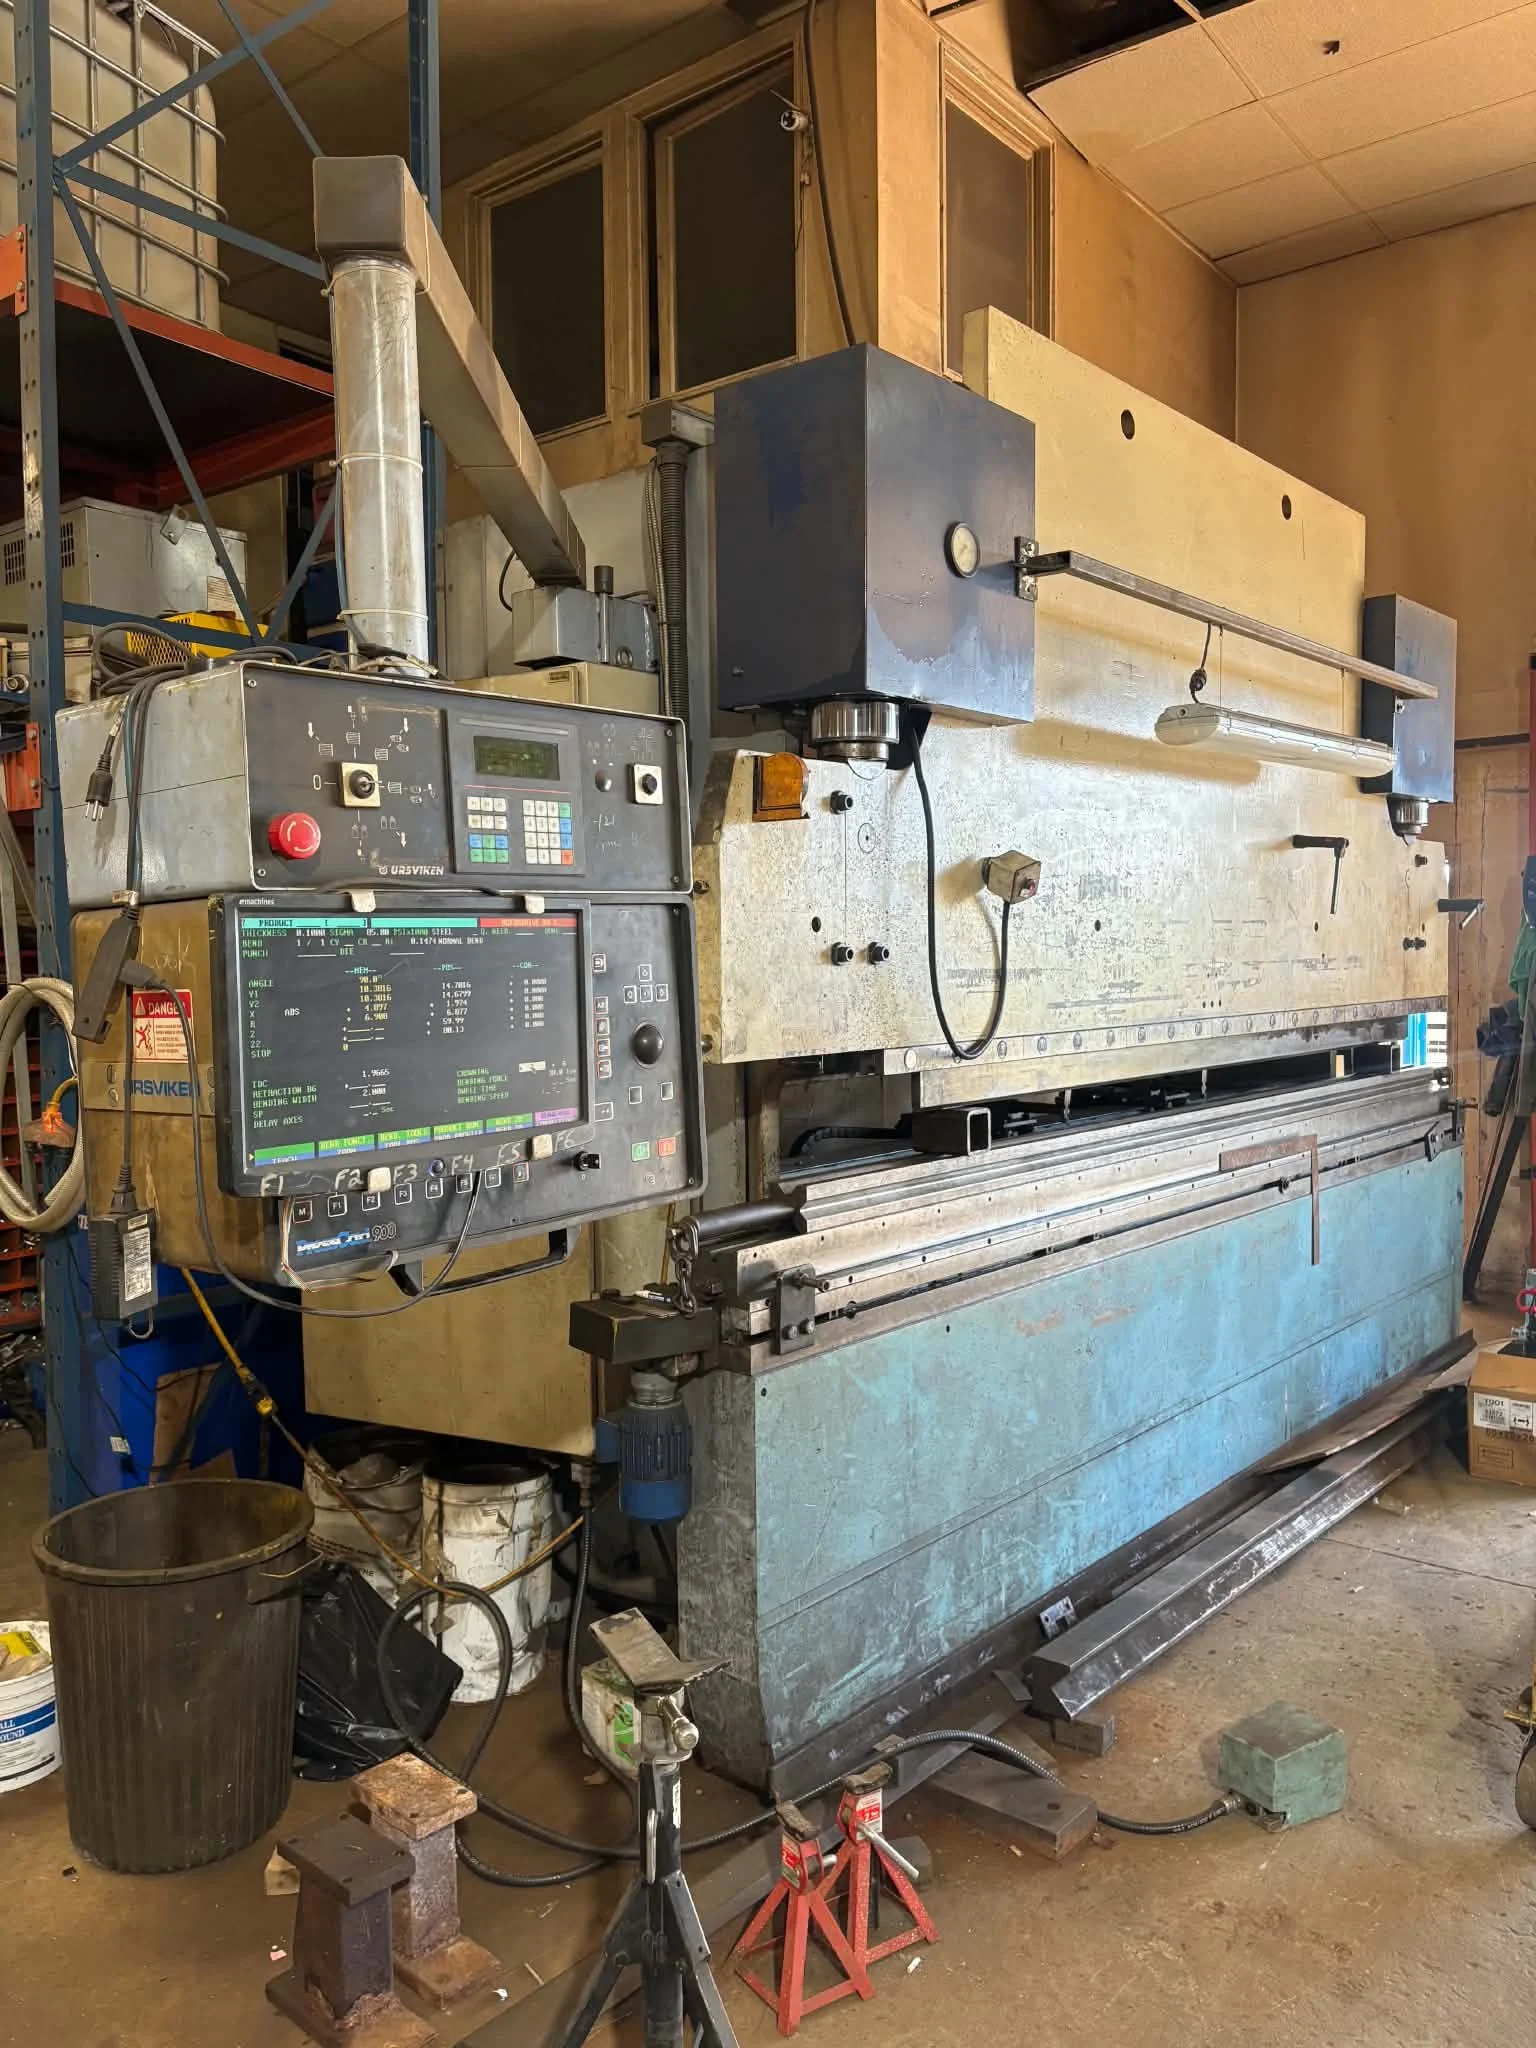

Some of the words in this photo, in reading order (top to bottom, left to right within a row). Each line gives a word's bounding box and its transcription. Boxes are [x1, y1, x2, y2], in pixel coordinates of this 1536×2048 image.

[390, 866, 444, 876] URSVIKEN
[258, 919, 293, 927] PRODUCT
[242, 929, 288, 937] THICKNESS
[148, 1001, 185, 1016] DANGE
[252, 1086, 302, 1098] RETRACTION
[252, 1098, 288, 1109] BENDING
[292, 1094, 317, 1104] WIDTH
[254, 1118, 278, 1128] DELAY
[283, 1116, 304, 1125] AXES
[451, 1154, 474, 1176] F4
[335, 1168, 364, 1190] F2
[394, 1164, 418, 1184] F3
[260, 1174, 284, 1196] F1
[400, 1190, 408, 1198] F3
[298, 1208, 307, 1216] M
[332, 1202, 343, 1210] F1
[372, 1222, 398, 1242] 900
